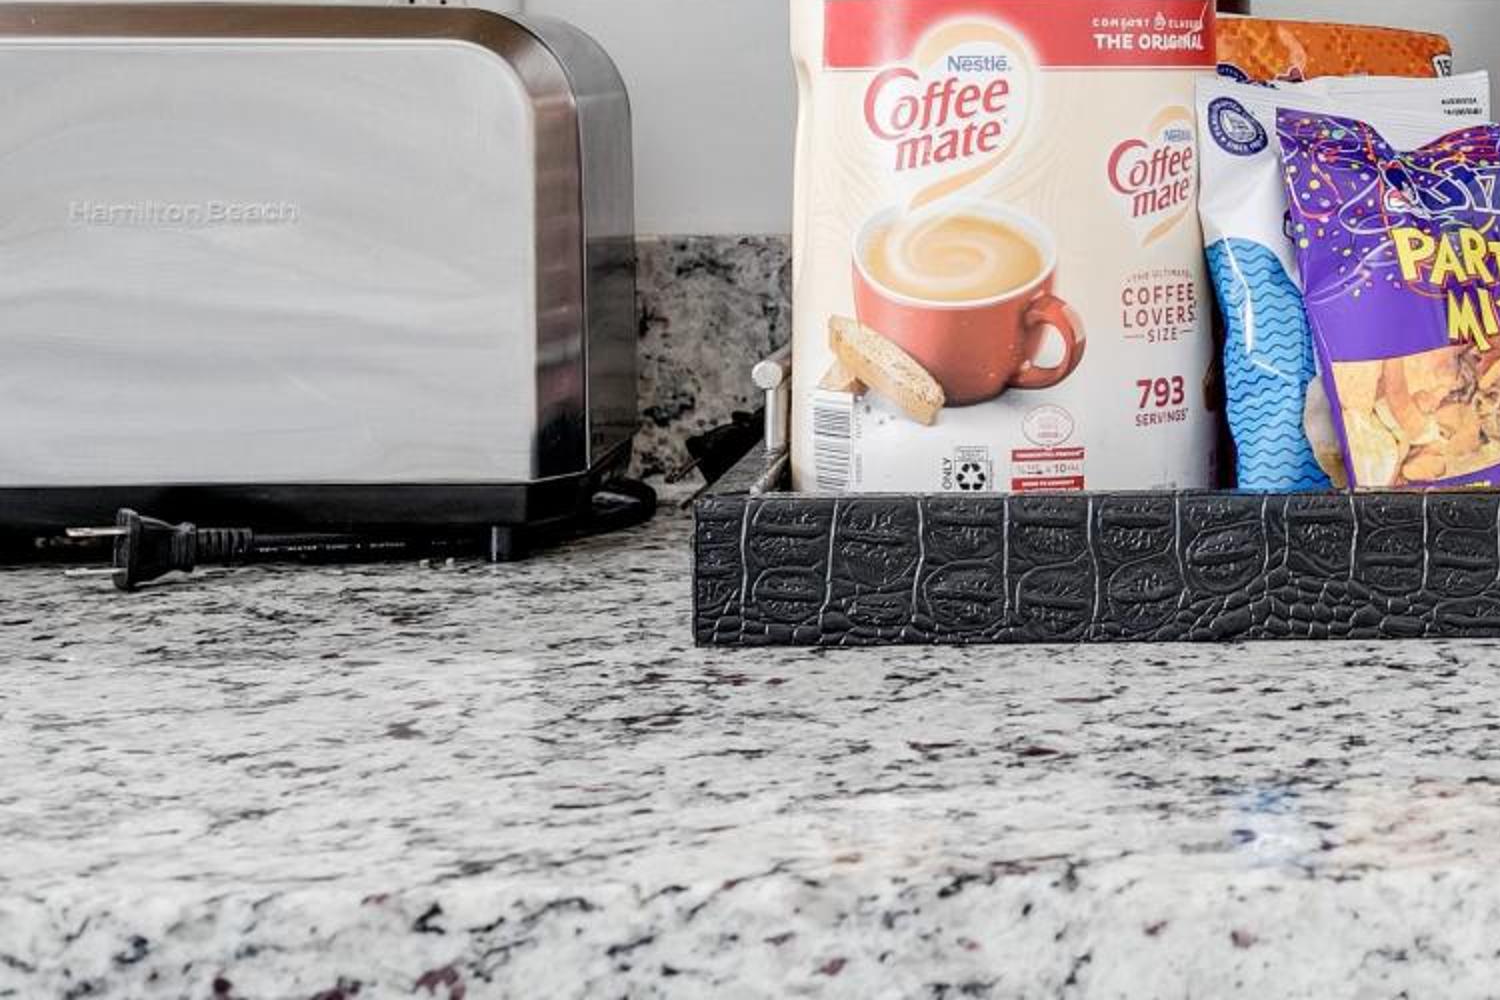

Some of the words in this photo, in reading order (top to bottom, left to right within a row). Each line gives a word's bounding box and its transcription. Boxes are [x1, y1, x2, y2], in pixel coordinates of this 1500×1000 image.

[1093, 33, 1135, 50] THE
[1138, 33, 1204, 51] ORIGINAL
[863, 66, 1010, 141] Coffee
[895, 119, 1002, 171] mate
[1107, 138, 1193, 194] Coffee
[68, 200, 199, 222] Hamilton
[207, 200, 300, 221] Beach
[1133, 177, 1189, 218] mate
[1121, 282, 1195, 306] COFFEE
[1147, 326, 1178, 343] SIZE
[1135, 375, 1185, 409] 793
